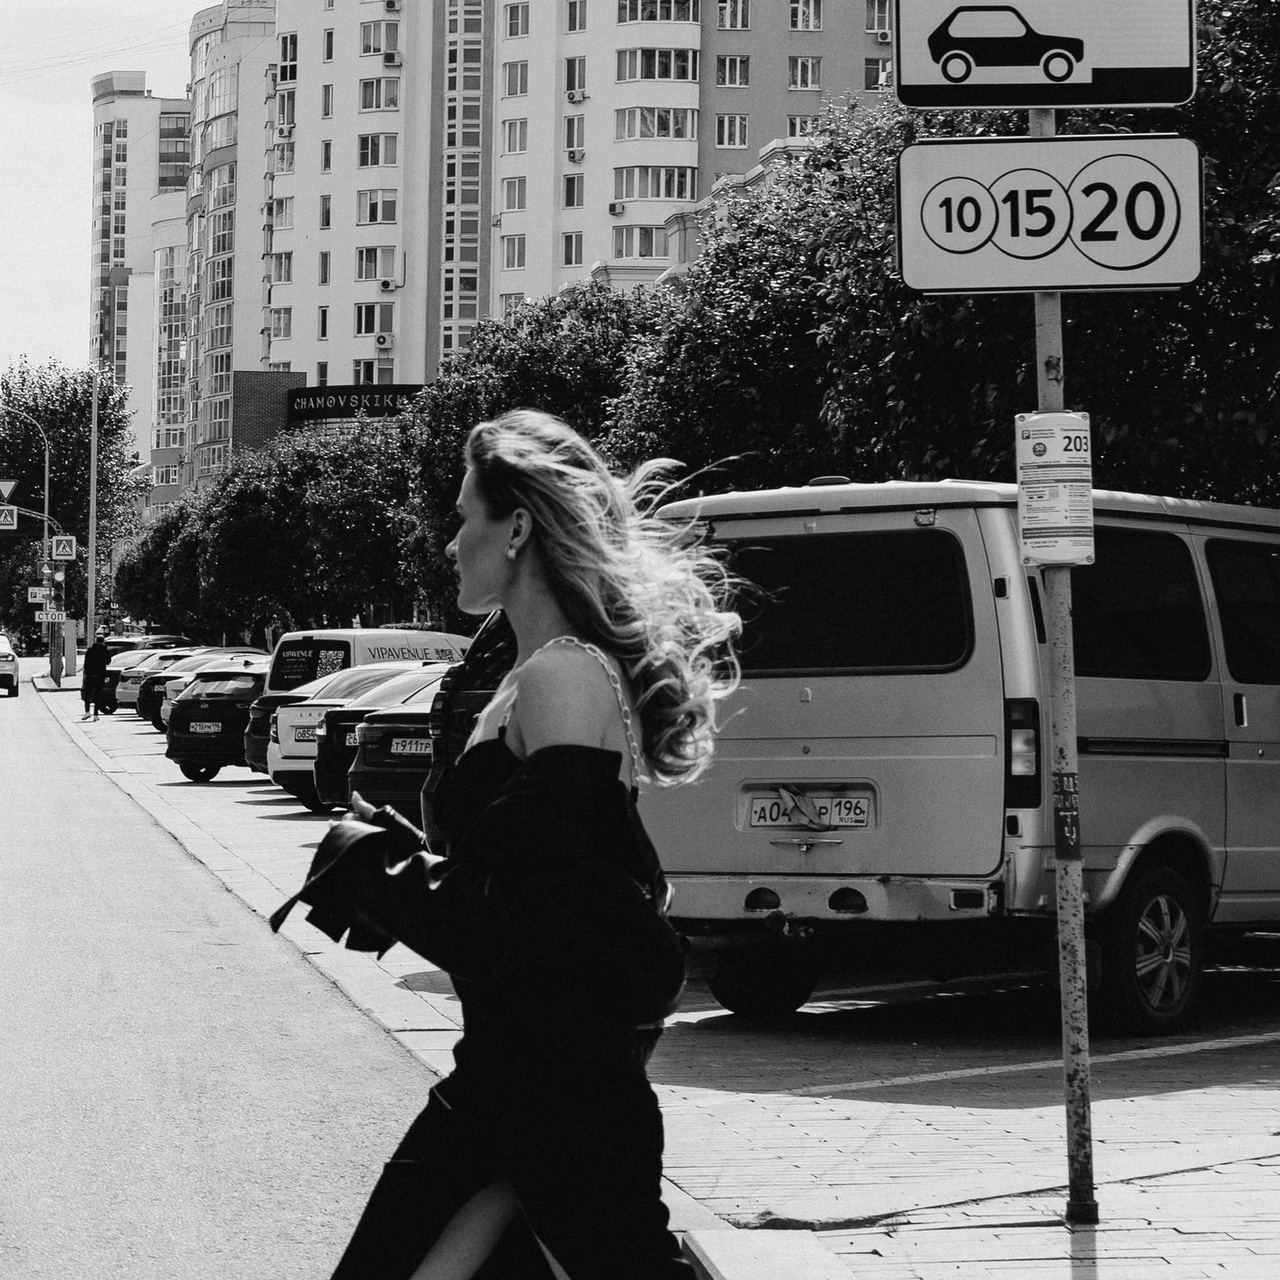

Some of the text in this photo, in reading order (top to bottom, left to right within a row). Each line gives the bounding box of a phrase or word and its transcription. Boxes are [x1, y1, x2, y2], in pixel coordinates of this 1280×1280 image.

[938, 181, 1166, 242] 10 15 20
[1062, 435, 1089, 452] 203
[38, 612, 64, 621] СТОП
[367, 647, 431, 661] VIPAVENUE
[395, 740, 431, 752] Т911ТР
[757, 800, 863, 822] А04Р 196
